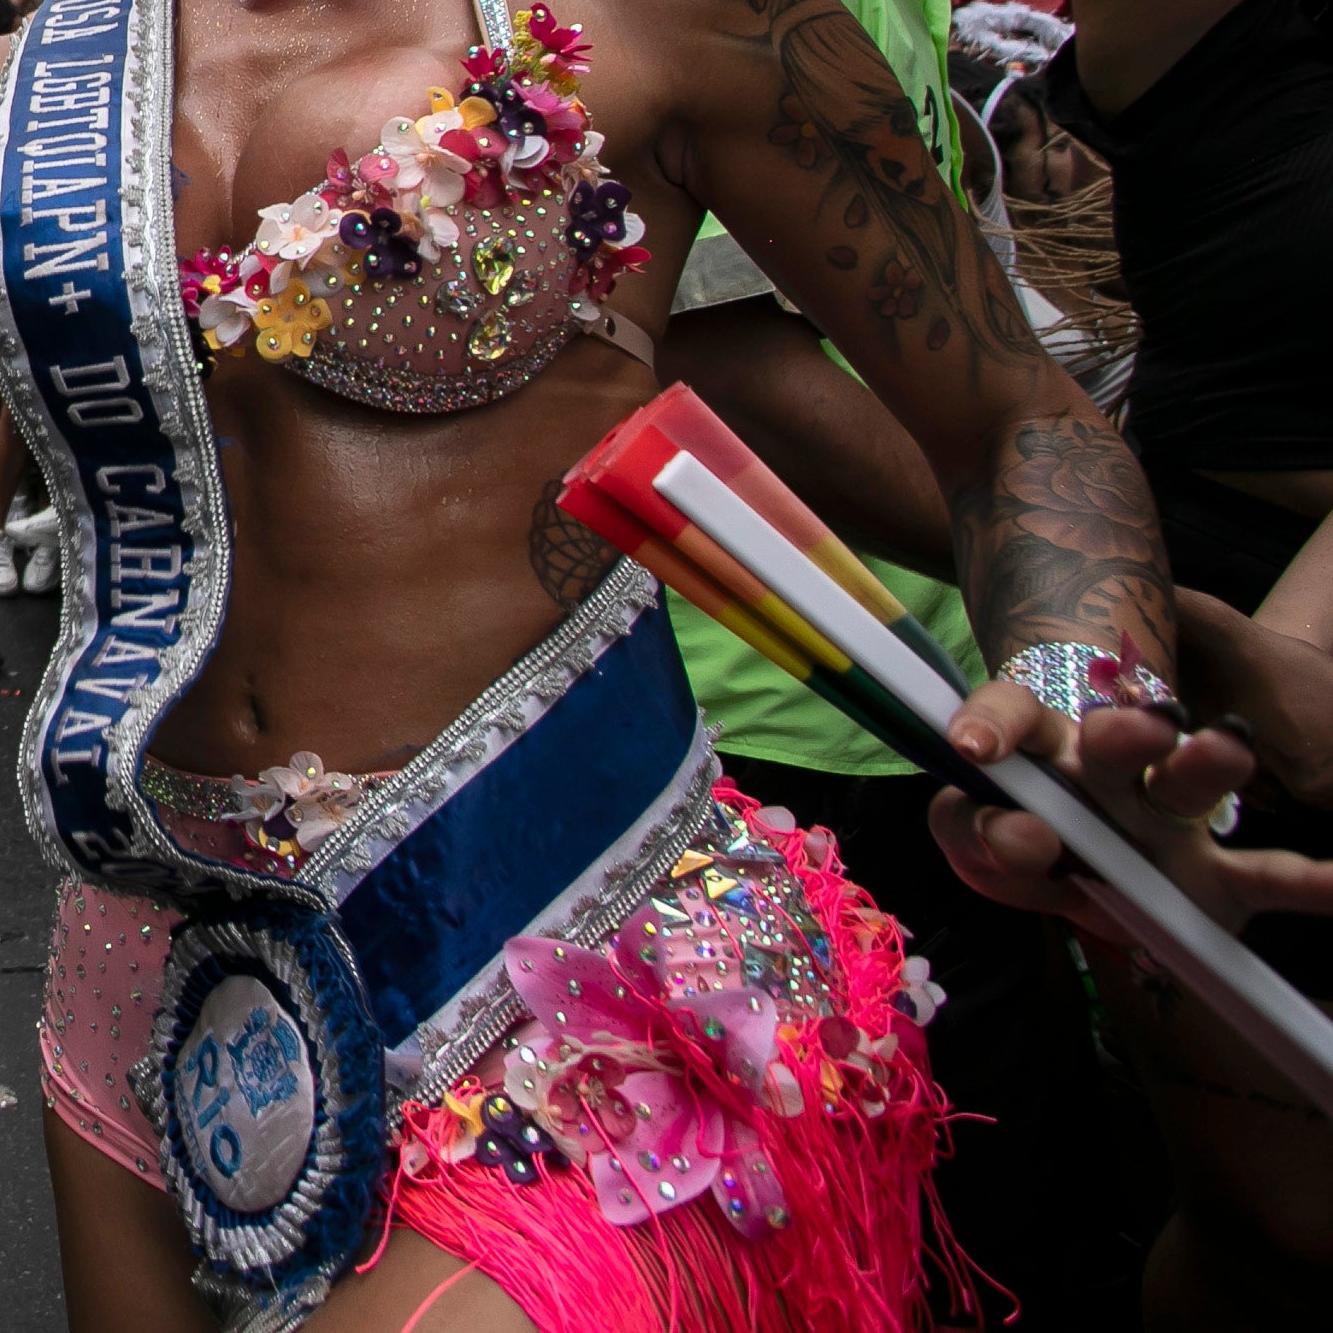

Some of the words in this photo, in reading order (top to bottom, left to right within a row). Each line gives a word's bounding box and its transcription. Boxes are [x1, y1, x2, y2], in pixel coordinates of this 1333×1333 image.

[16, 54, 114, 316] LGBTQIAPN+
[49, 356, 144, 430] DO
[51, 464, 183, 786] CARNAVAL
